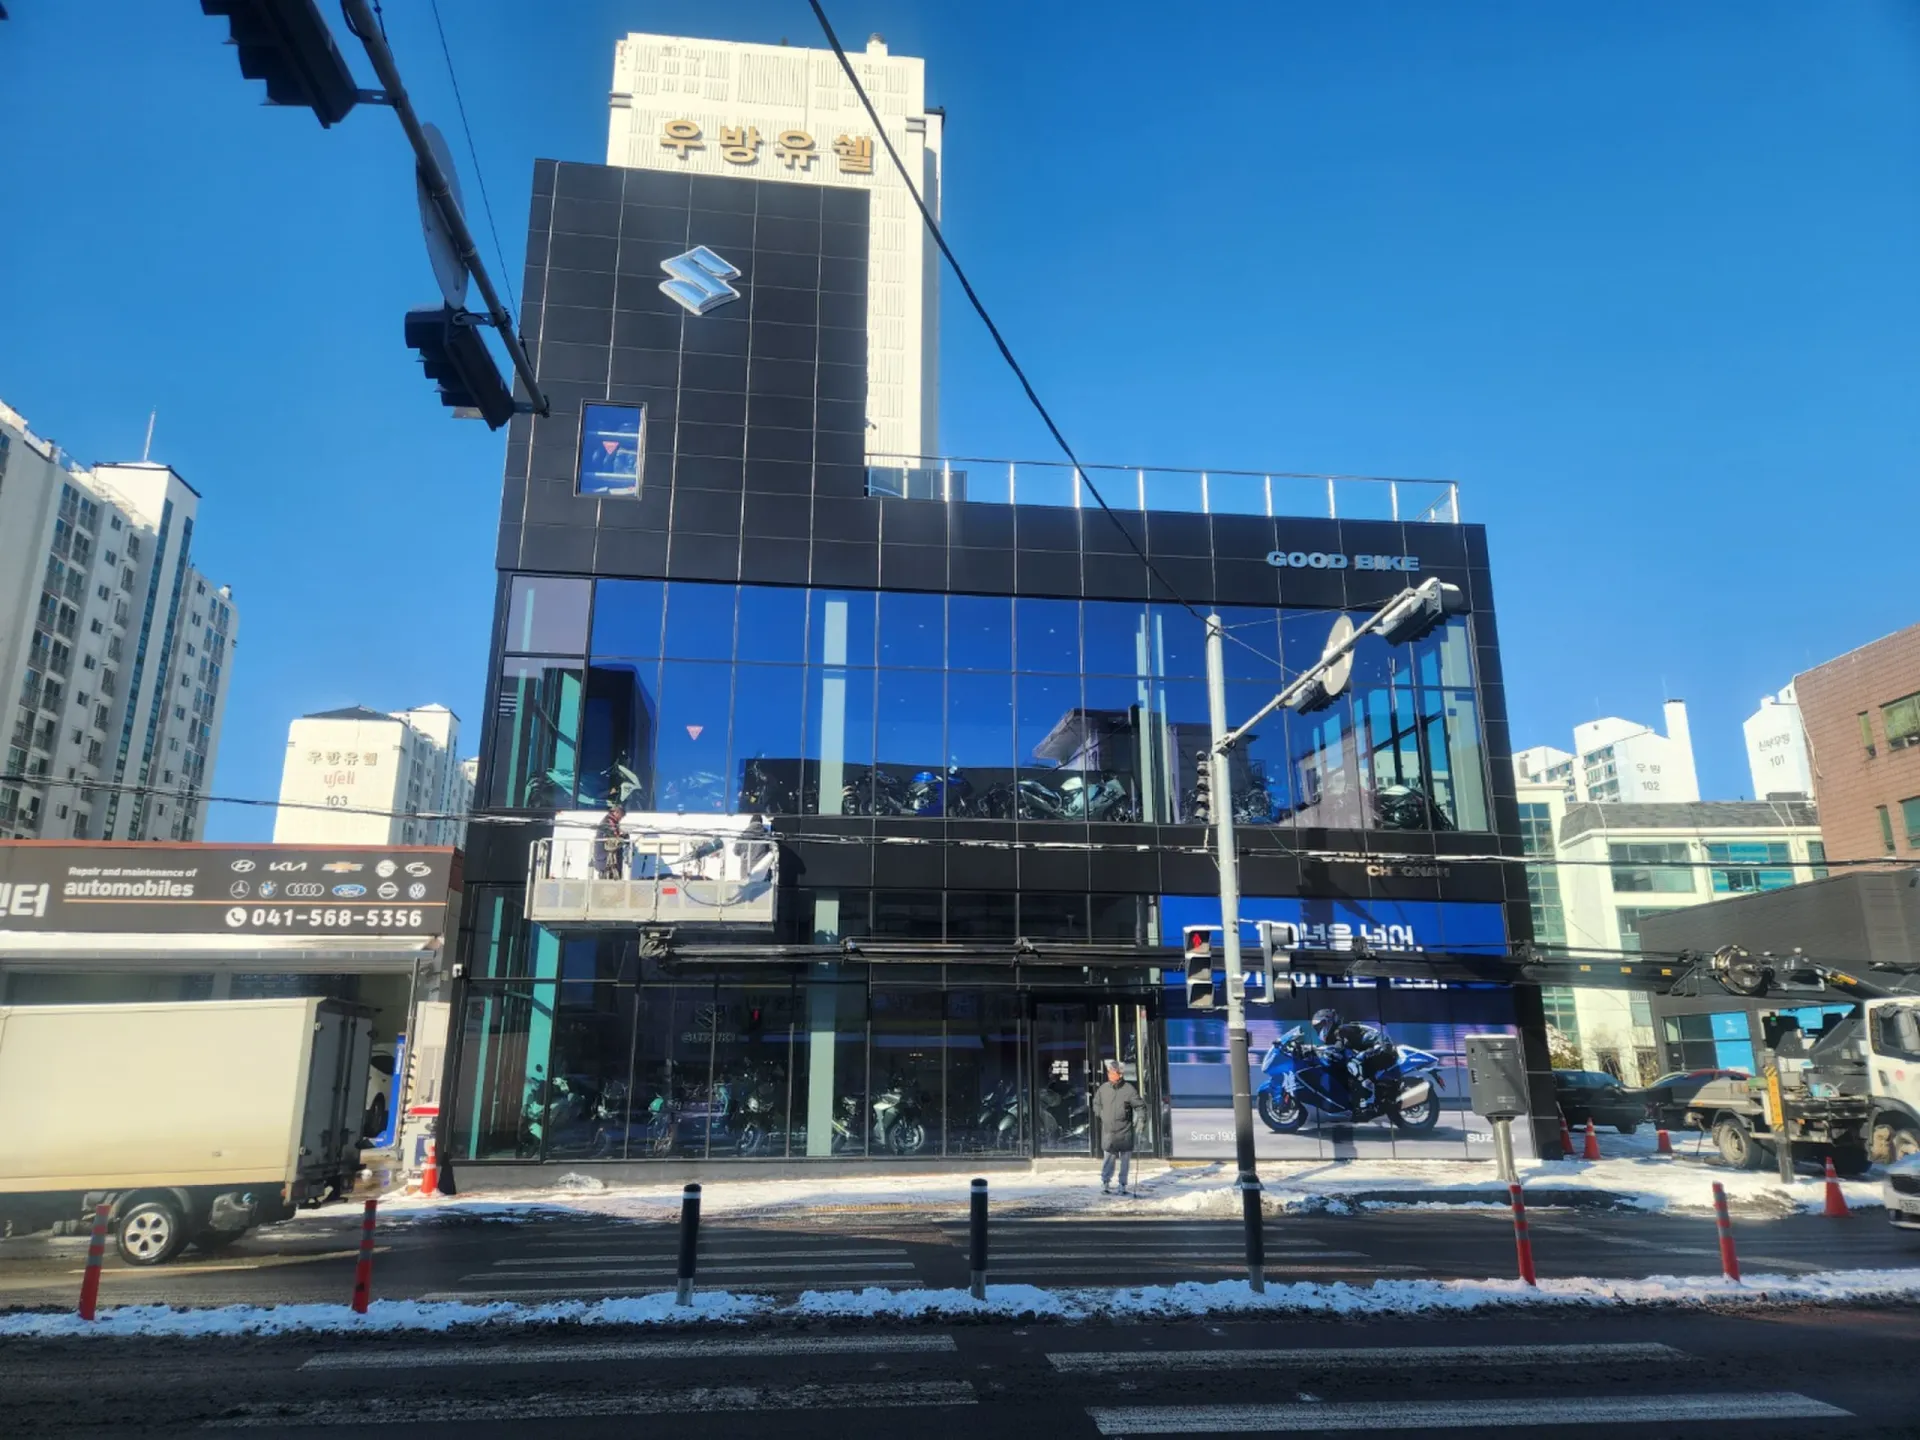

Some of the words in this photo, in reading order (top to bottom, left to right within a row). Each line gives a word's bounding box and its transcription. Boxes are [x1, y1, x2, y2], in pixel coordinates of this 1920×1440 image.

[1266, 551, 1348, 569] GOOD
[1354, 555, 1420, 571] BIKE
[1769, 754, 1785, 768] 101
[1641, 780, 1661, 791] 102
[325, 795, 348, 807] 103
[68, 867, 101, 877] Repair
[102, 867, 121, 877] and
[122, 867, 184, 877] maintenance
[185, 868, 198, 877] of
[64, 879, 194, 897] automobiles
[251, 908, 422, 927] 041-568-5356
[1466, 1133, 1516, 1143] SUZI
